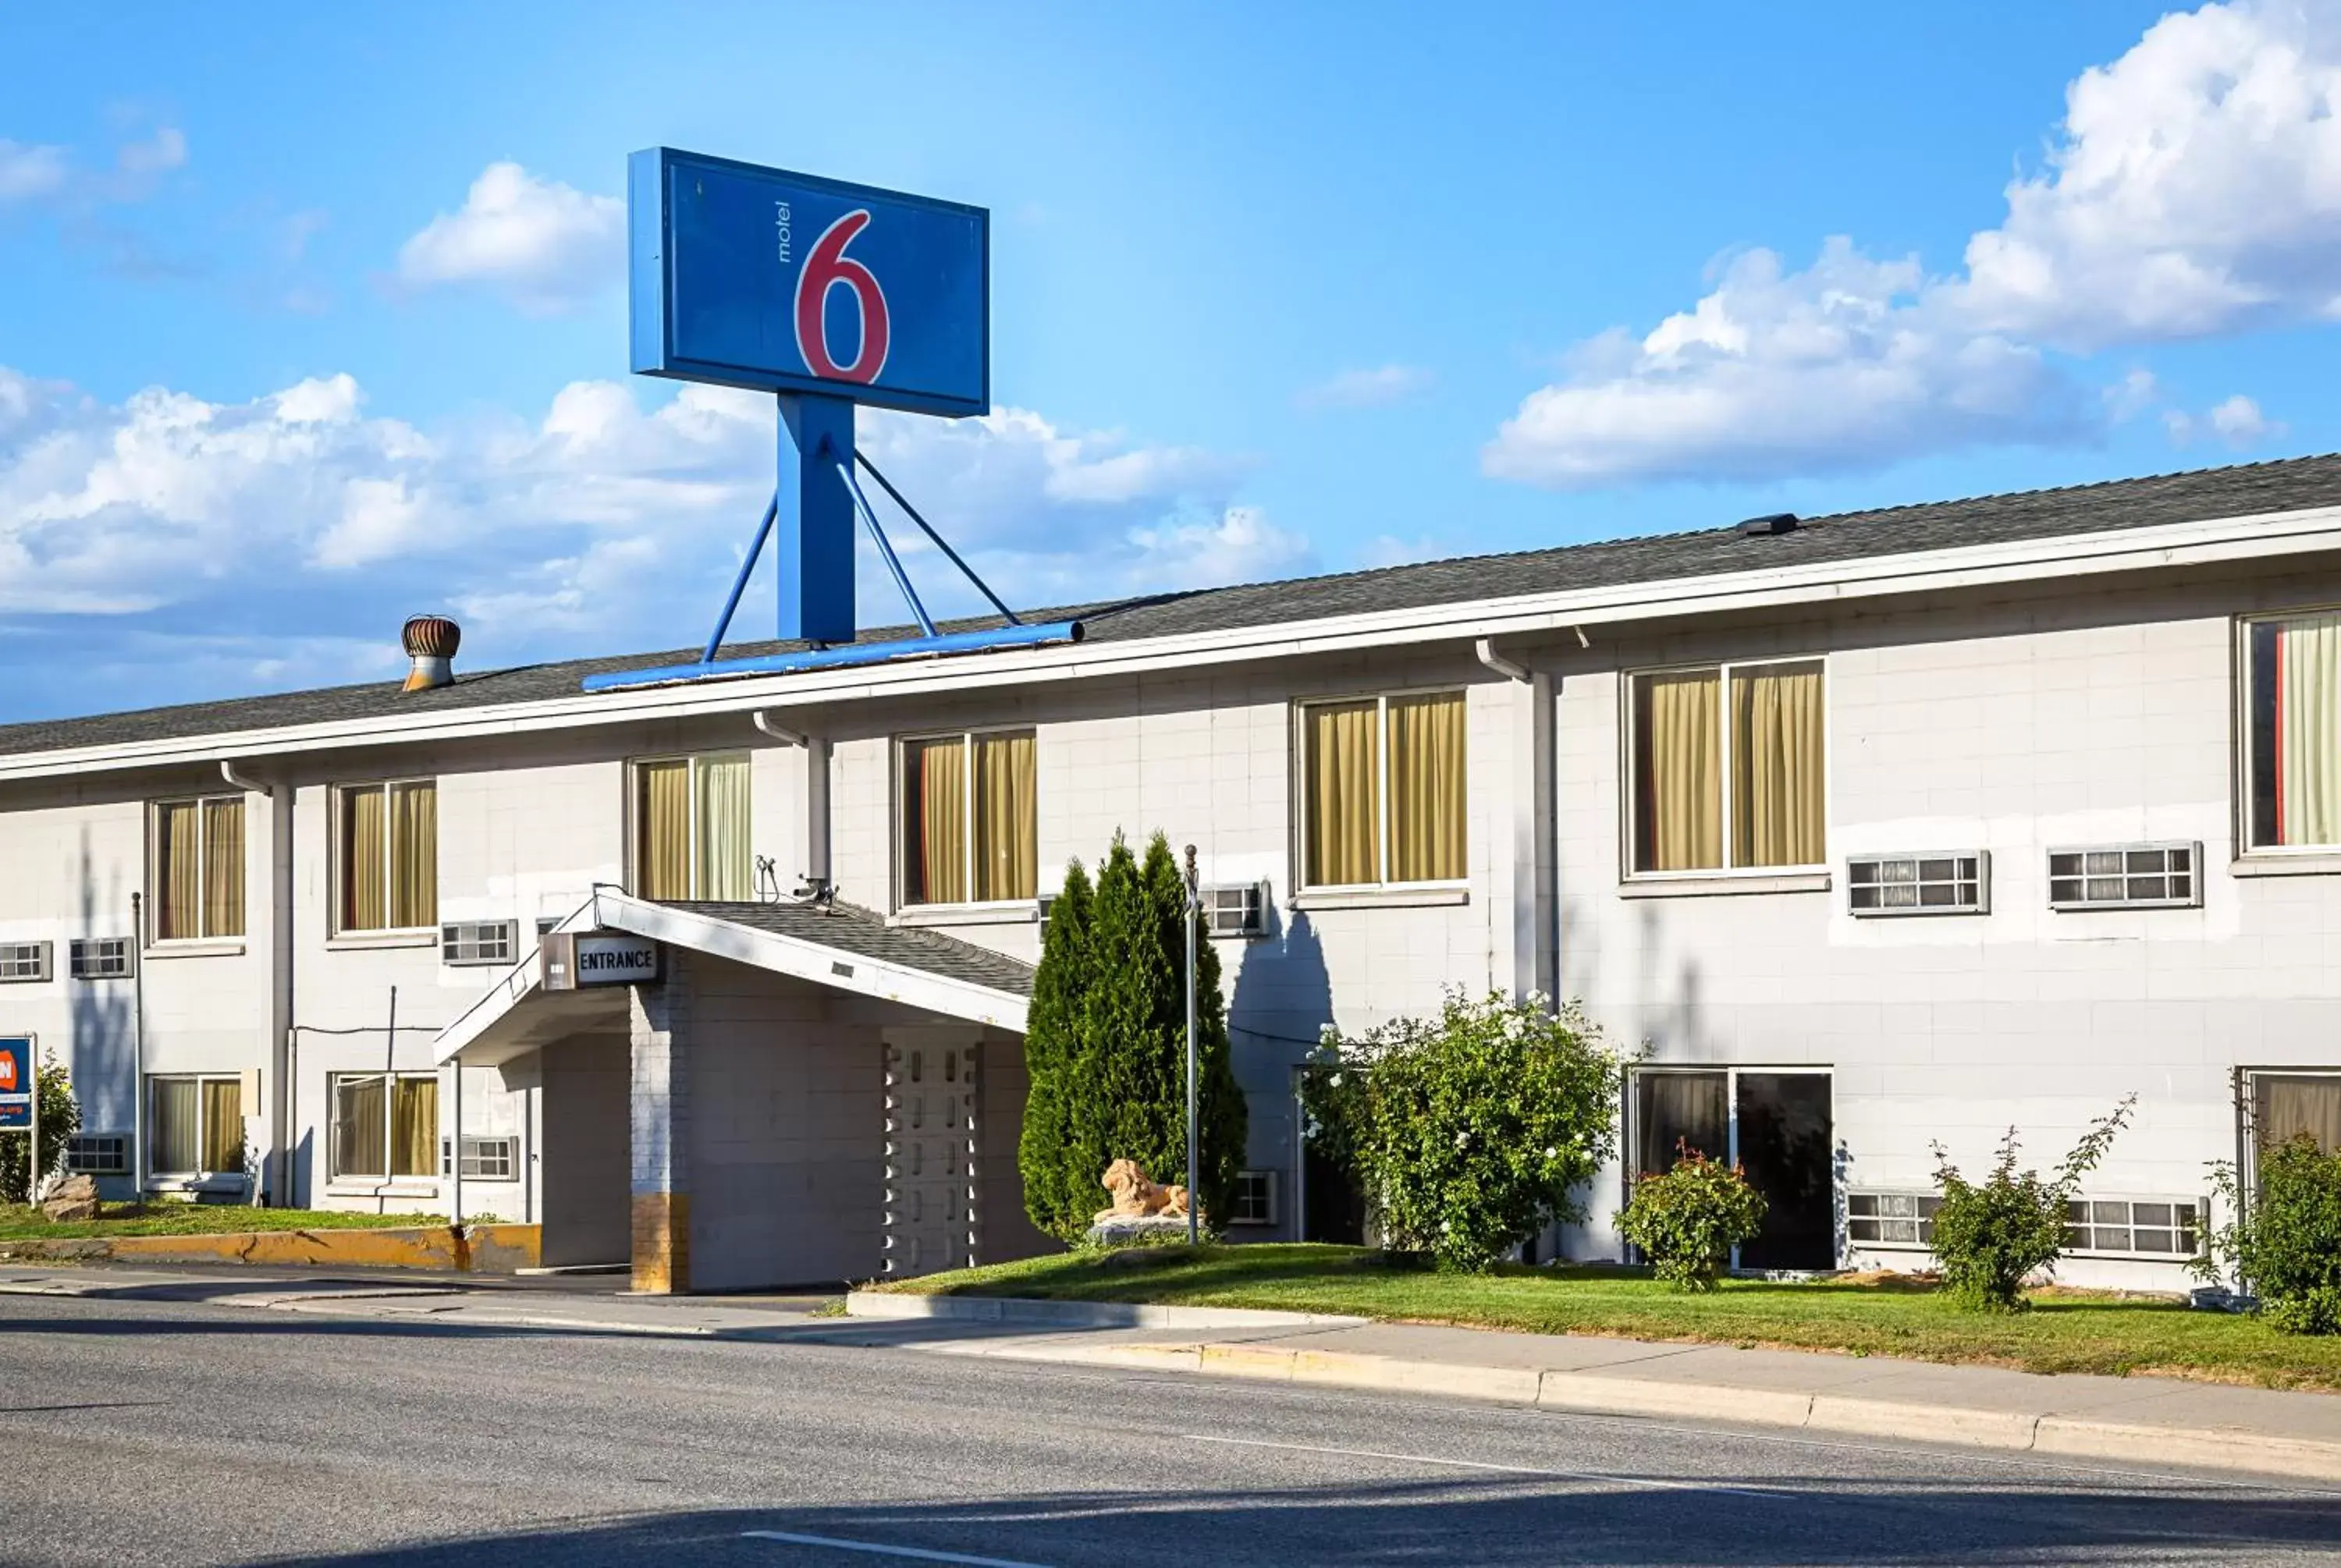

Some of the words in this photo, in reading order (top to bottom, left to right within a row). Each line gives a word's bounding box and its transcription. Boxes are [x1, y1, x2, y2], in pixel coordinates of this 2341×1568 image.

[775, 201, 790, 263] motel
[794, 209, 890, 384] 6
[580, 950, 653, 970] ENTRANCE
